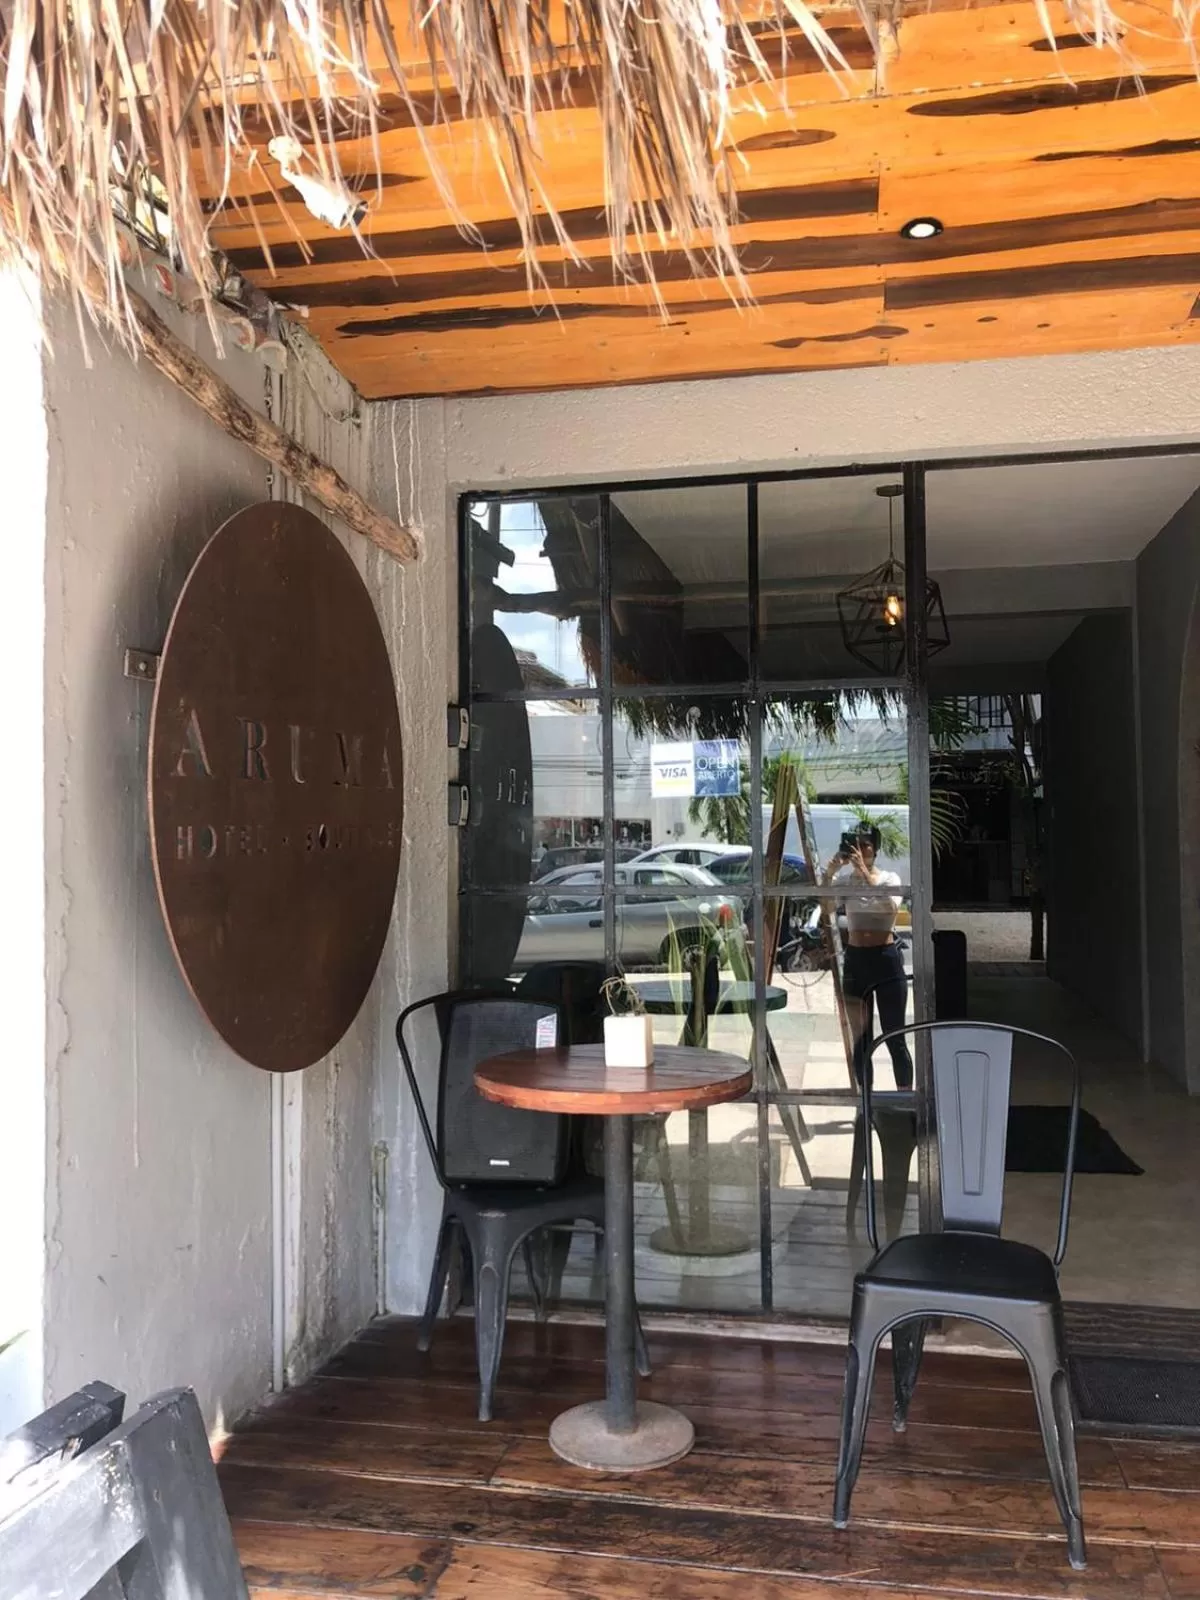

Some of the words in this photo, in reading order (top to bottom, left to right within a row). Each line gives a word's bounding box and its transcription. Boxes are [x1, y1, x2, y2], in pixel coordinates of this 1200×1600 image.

[170, 709, 396, 790] ARUMA
[659, 768, 688, 778] VISA
[697, 757, 736, 769] OPEN
[176, 824, 268, 861] HOTEL
